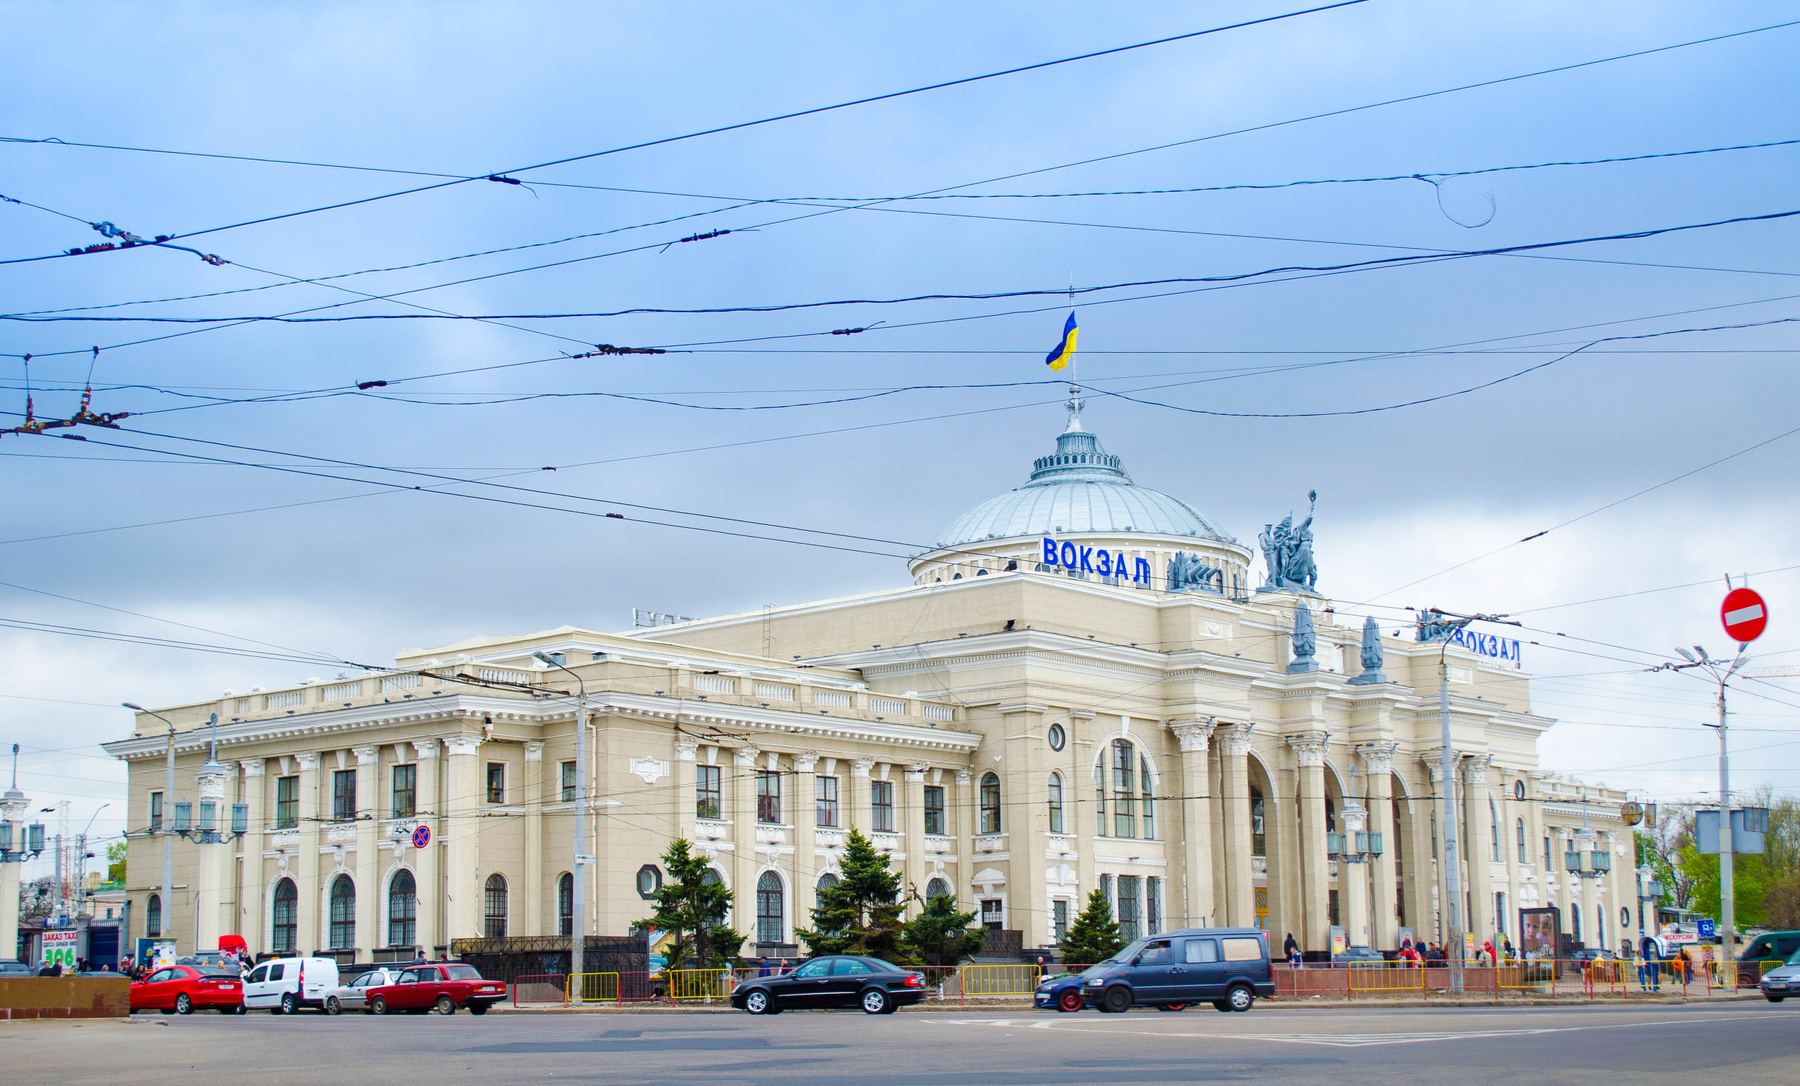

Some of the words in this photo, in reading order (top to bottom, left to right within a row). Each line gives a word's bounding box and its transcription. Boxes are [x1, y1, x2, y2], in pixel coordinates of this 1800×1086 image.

[1043, 537, 1148, 584] ВОКЗАЛ
[1455, 628, 1520, 661] ВОКЗАЛ
[43, 933, 62, 941] ЗАКАЗ
[45, 948, 73, 967] 306
